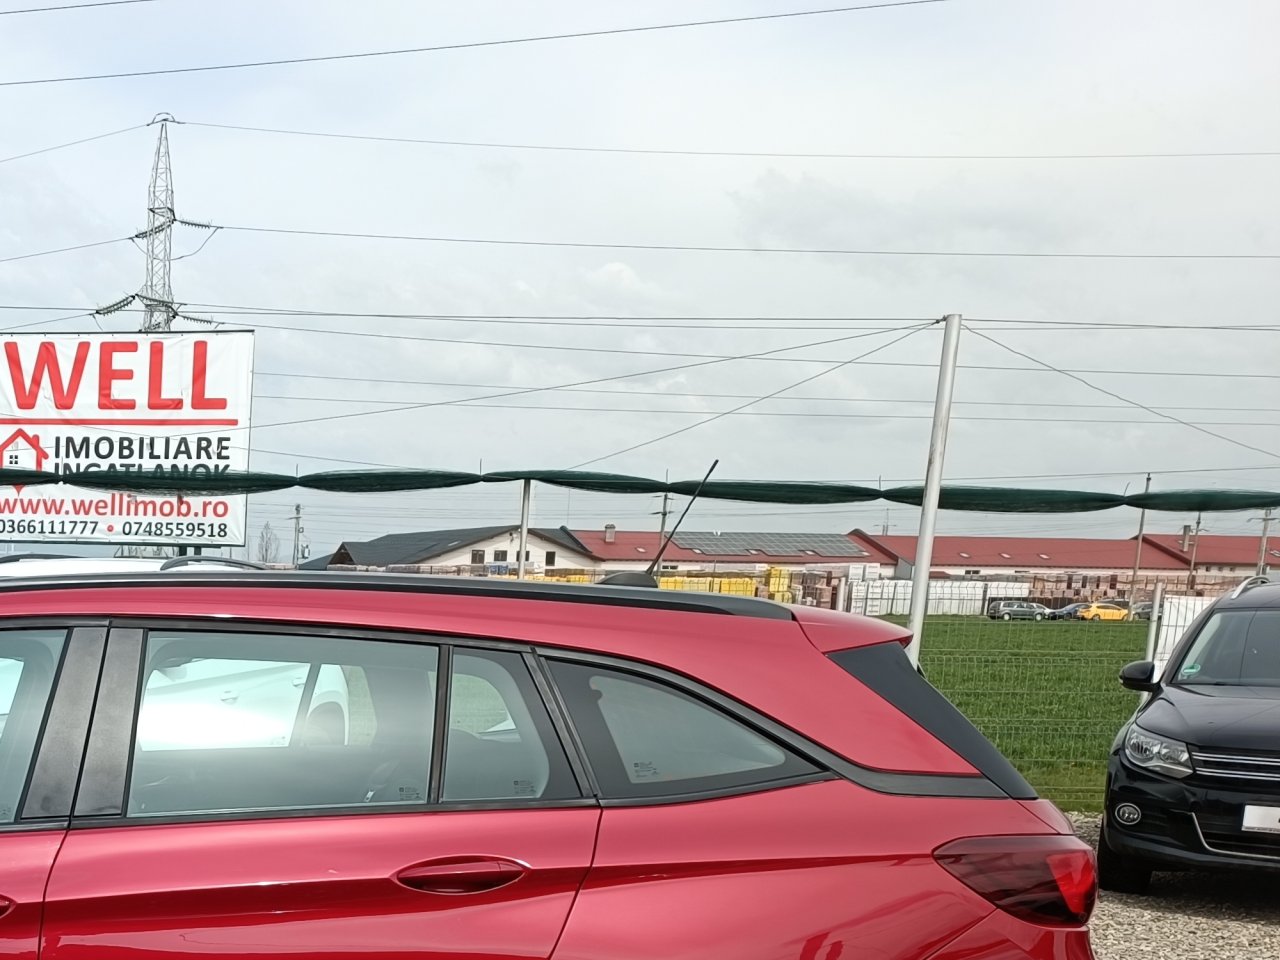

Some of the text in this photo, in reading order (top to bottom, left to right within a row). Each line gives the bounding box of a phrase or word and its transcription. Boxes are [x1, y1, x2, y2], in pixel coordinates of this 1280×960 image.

[4, 341, 228, 410] WELL
[54, 436, 231, 460] IMOBILIARE
[122, 520, 228, 538] 0748559518
